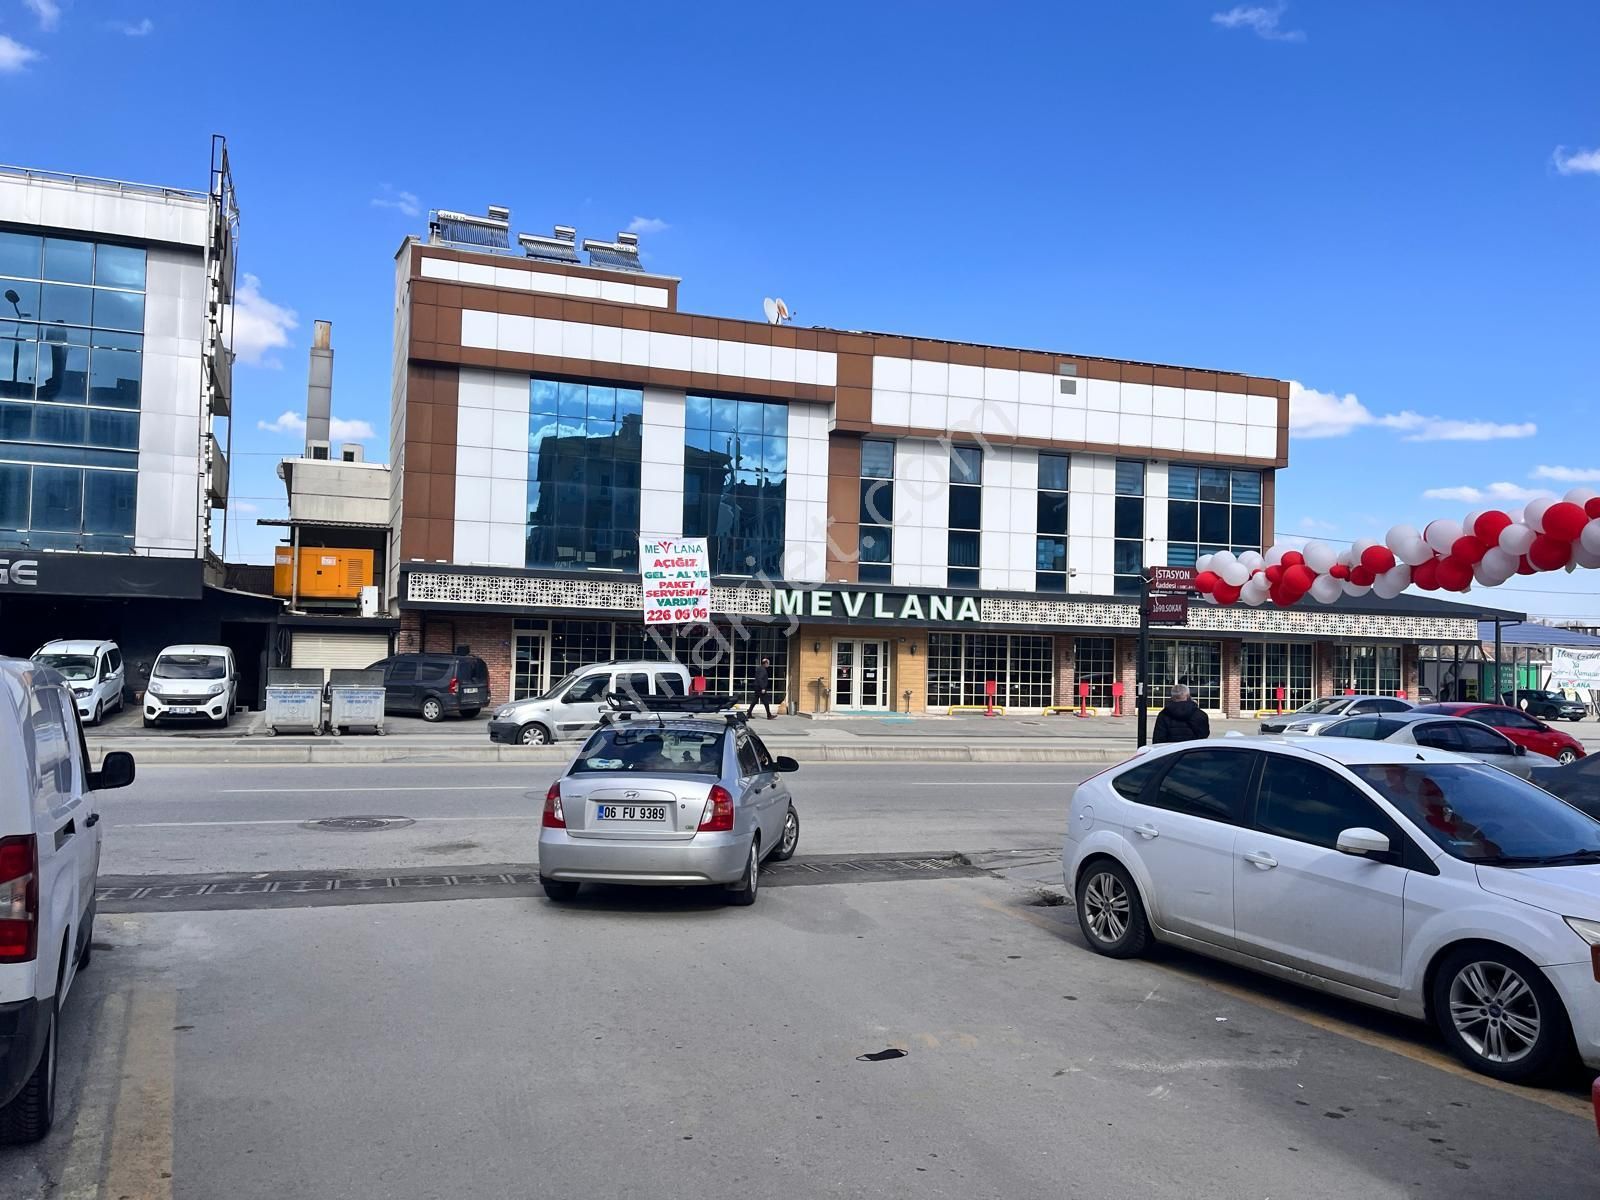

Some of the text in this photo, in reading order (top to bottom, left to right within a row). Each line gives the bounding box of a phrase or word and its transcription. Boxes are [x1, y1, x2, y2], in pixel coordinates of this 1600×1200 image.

[644, 541, 703, 554] MEVLANA
[644, 571, 666, 579] GEL
[693, 570, 708, 578] VE
[1155, 567, 1190, 580] İSTASYON
[659, 581, 695, 589] PAKET
[656, 597, 699, 607] VARDIR
[774, 588, 981, 622] MEVLANA
[646, 609, 671, 622] 226
[692, 607, 707, 619] 06
[604, 807, 665, 820] 06 FU 9389
